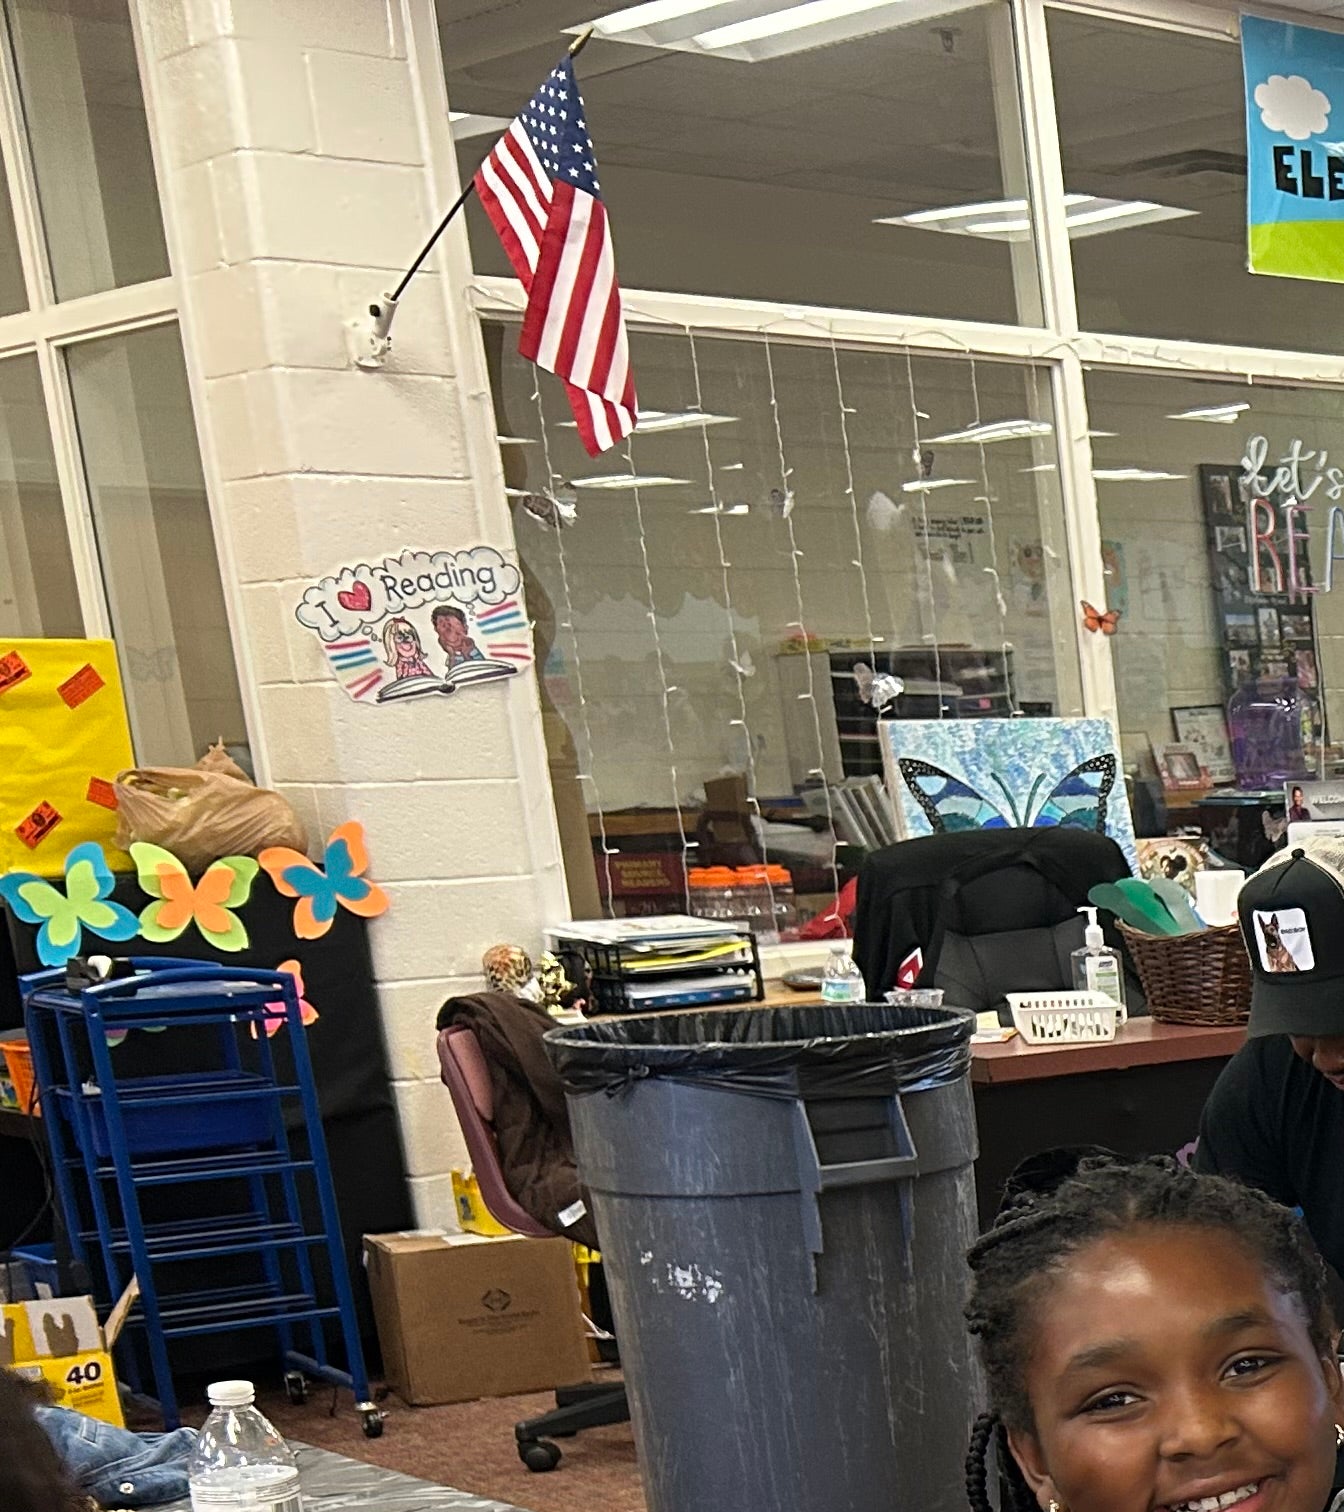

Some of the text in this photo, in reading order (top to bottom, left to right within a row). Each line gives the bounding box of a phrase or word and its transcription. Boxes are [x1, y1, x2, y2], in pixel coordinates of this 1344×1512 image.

[315, 562, 497, 628] I Reading
[66, 1361, 101, 1385] 40
